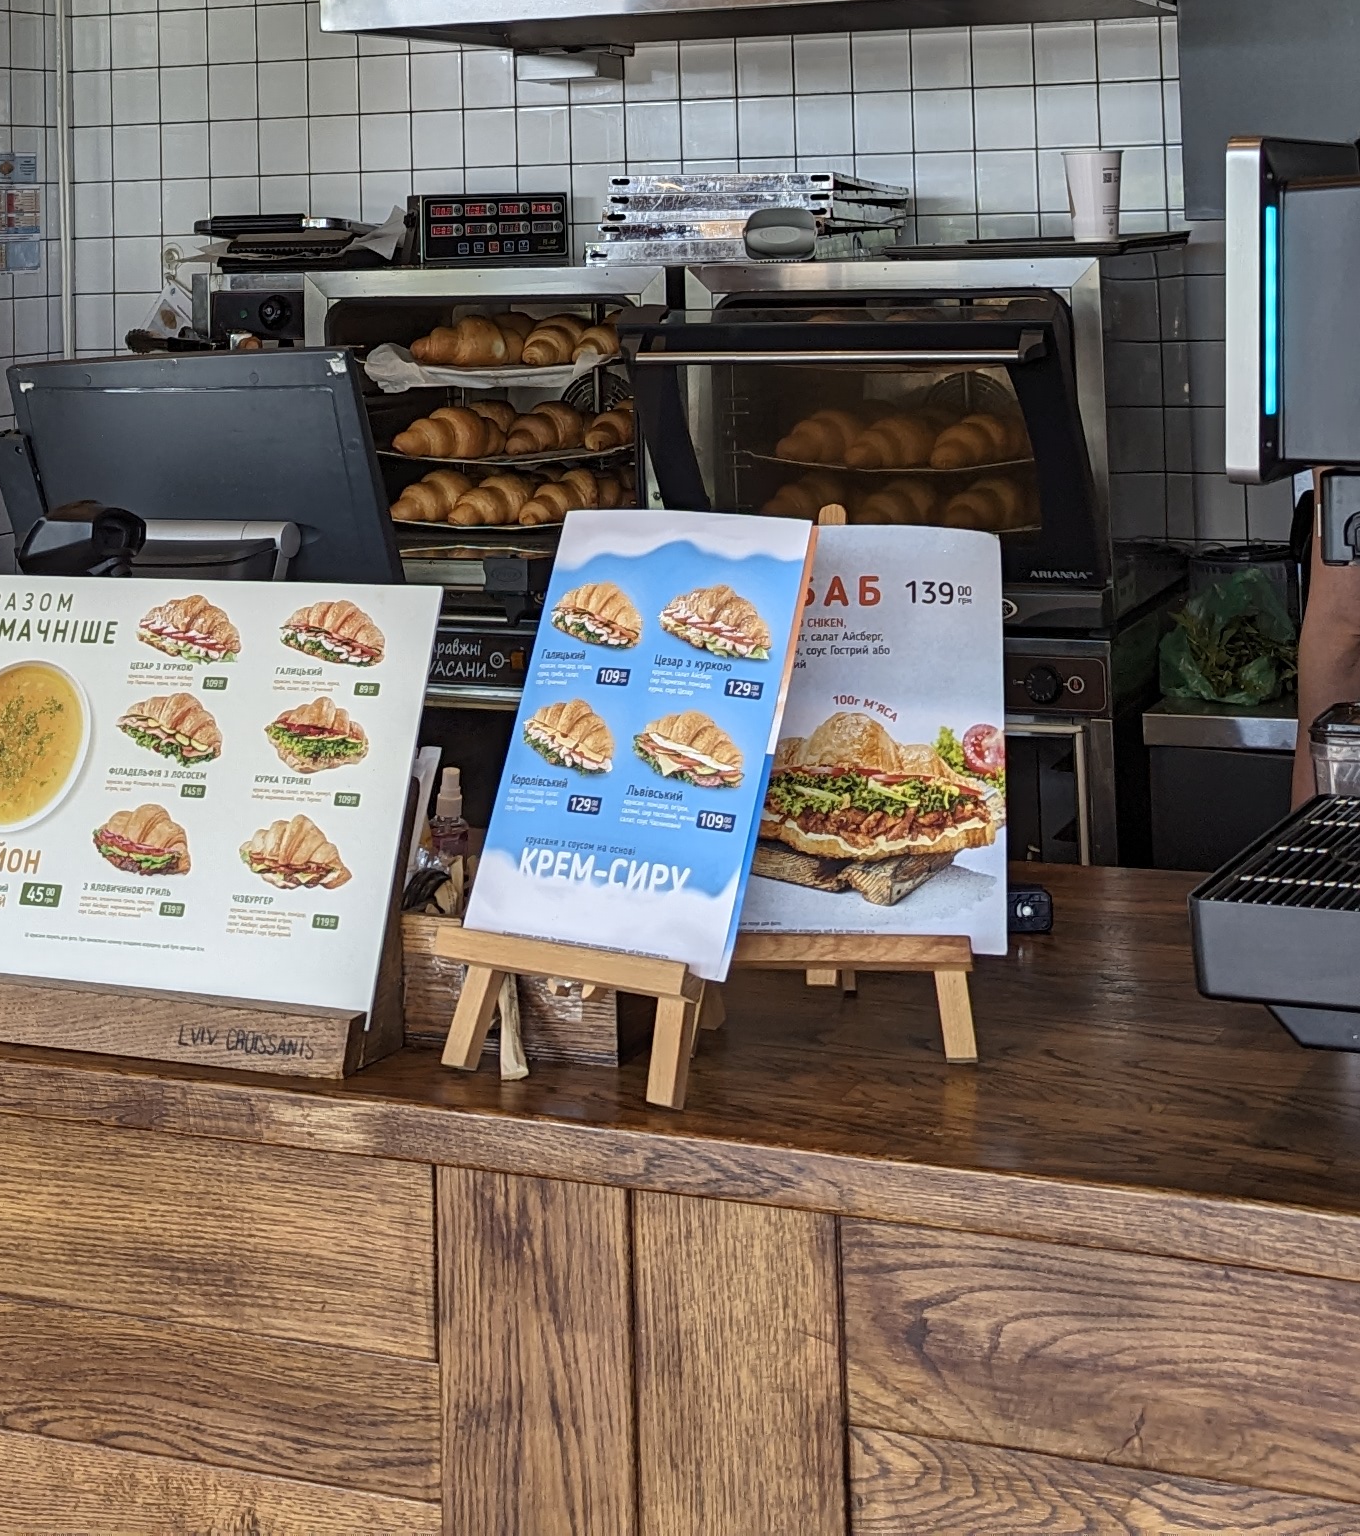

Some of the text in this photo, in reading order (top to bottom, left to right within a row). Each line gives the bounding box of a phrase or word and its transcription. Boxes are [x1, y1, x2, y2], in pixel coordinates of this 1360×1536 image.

[1030, 570, 1088, 580] ARIANNA
[906, 581, 954, 605] 139
[654, 654, 732, 673] Цезар з куркою
[728, 680, 750, 696] 129
[626, 784, 683, 801] Львівський
[700, 813, 723, 829] 109
[520, 847, 690, 893] КРЕМ-СИРУ
[26, 886, 44, 902] 45
